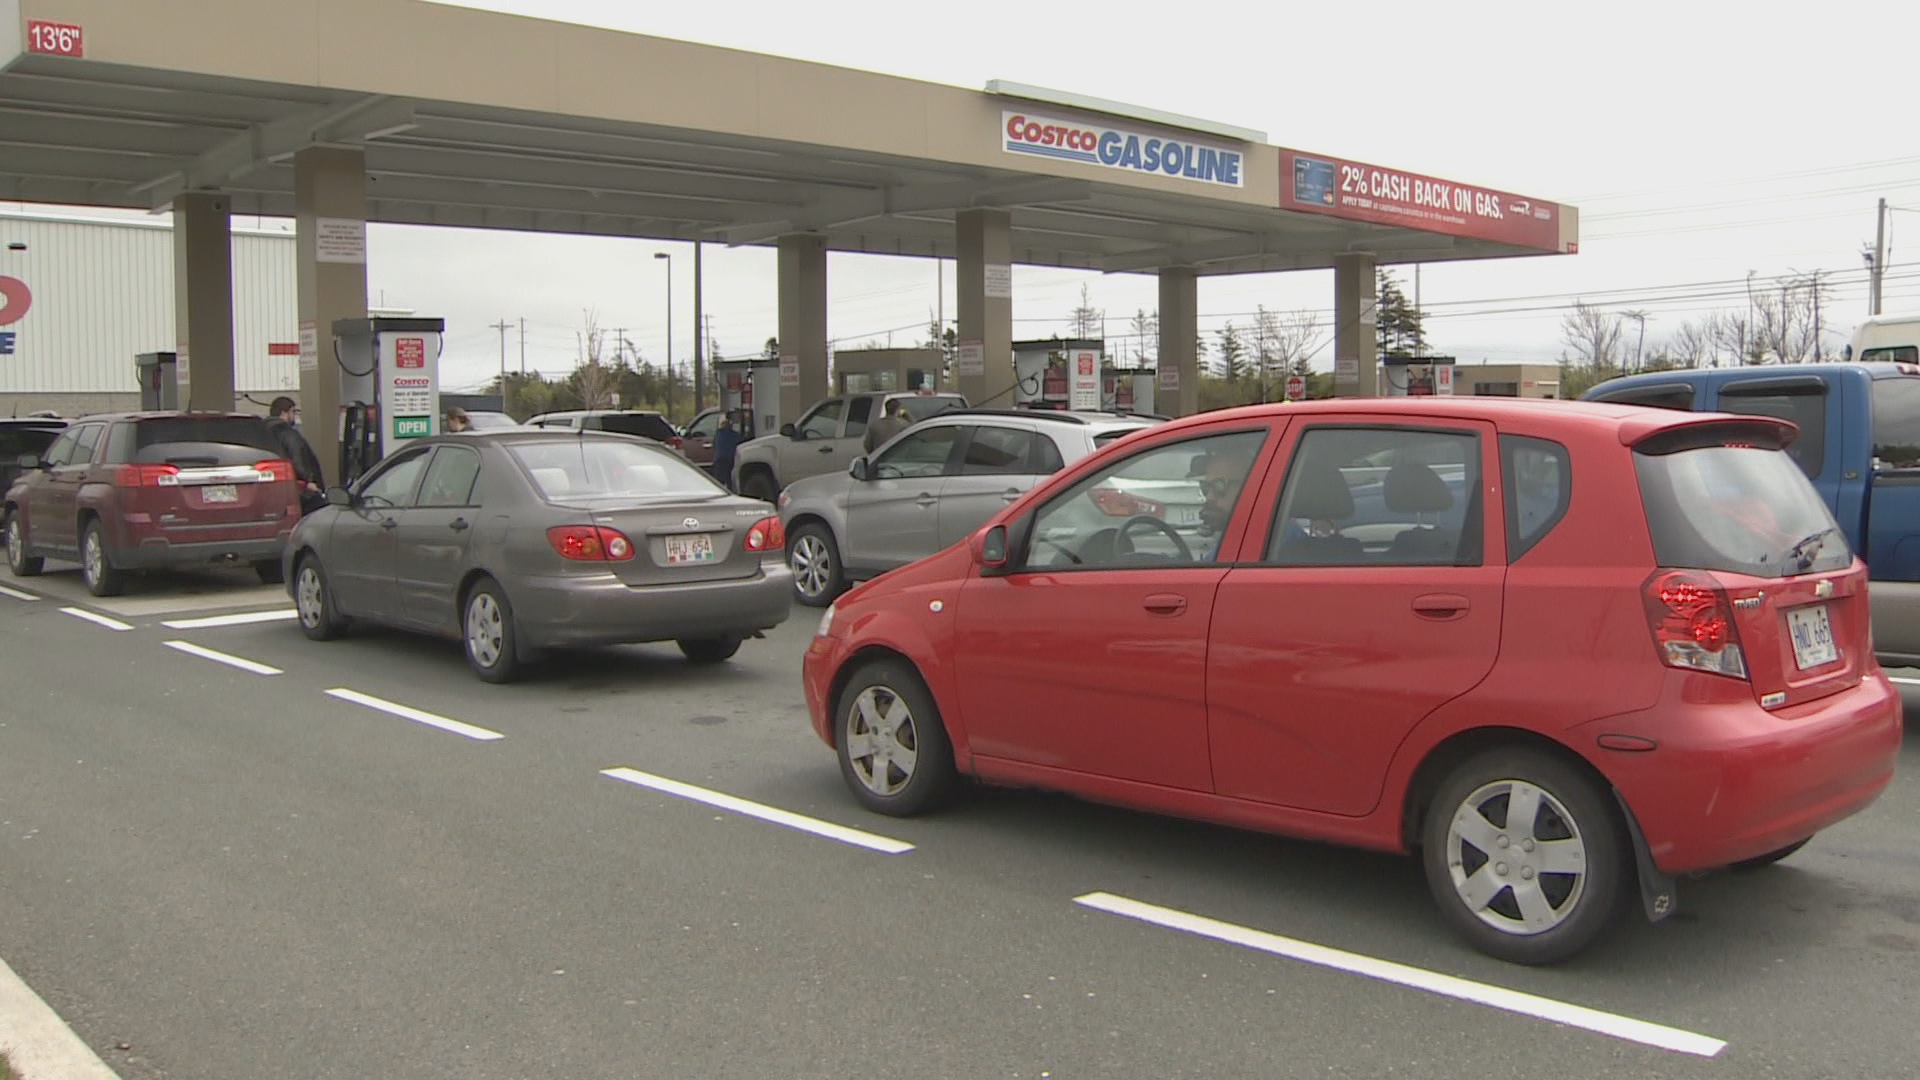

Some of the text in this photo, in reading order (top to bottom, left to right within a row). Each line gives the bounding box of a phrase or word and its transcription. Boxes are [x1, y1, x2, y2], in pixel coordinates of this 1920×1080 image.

[32, 25, 80, 52] 13'6"
[1007, 115, 1240, 184] COSTCO GASOLINE
[1342, 165, 1368, 194] 2%
[1372, 171, 1410, 202] CASH
[1415, 180, 1450, 210] BACK
[1454, 188, 1471, 213] ON
[1476, 192, 1503, 219] GAS.
[1288, 383, 1304, 393] STOP
[399, 421, 427, 434] OPEN
